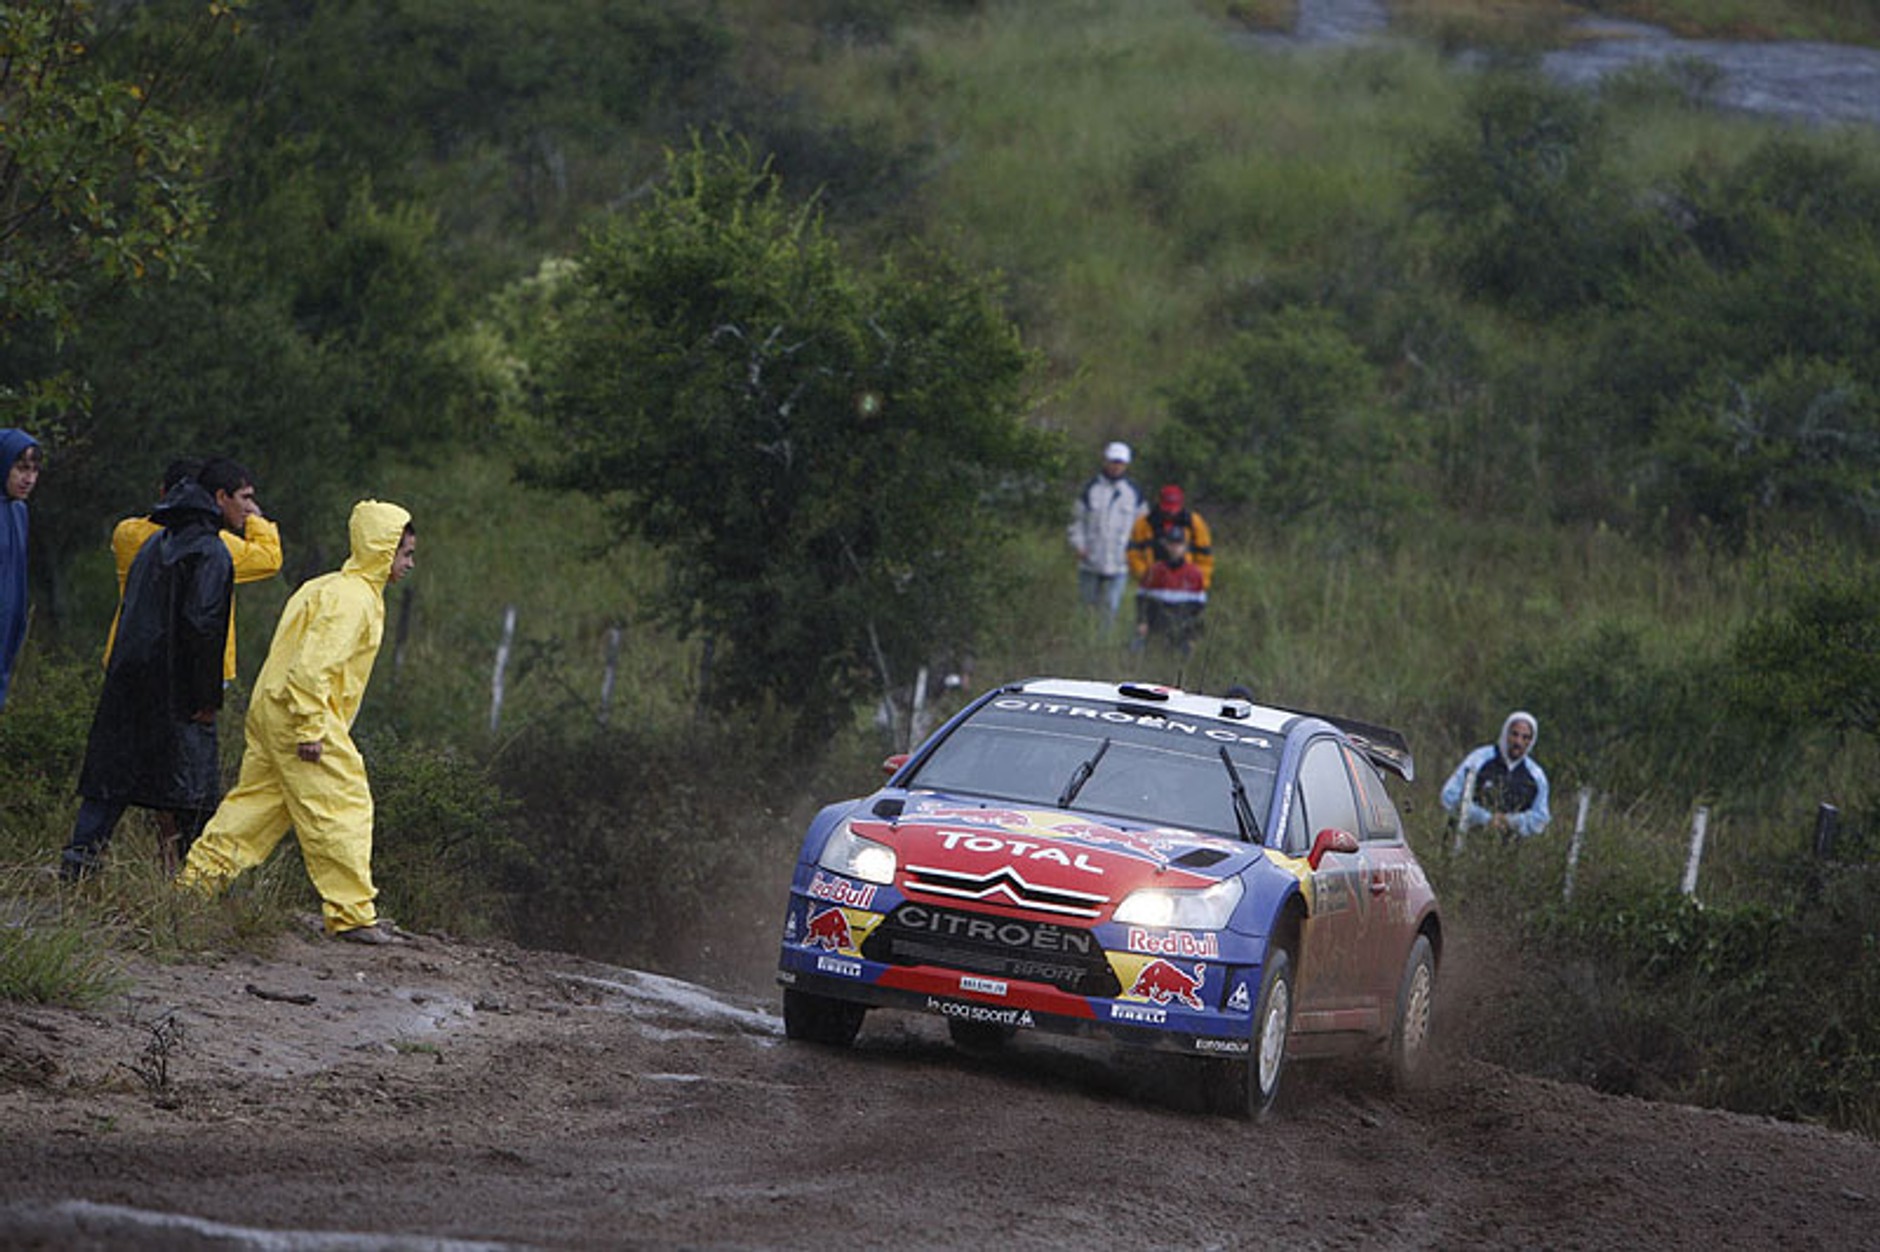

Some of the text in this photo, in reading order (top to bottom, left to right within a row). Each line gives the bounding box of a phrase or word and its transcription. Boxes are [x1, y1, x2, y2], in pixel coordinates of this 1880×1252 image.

[1205, 728, 1273, 748] C4
[936, 831, 1104, 875] TOTAL
[831, 879, 878, 909] Bull
[897, 906, 1091, 953] CITROËN
[1128, 927, 1218, 959] Red Bull
[941, 1003, 970, 1020] coq
[971, 1006, 1019, 1024] sportif
[1111, 1004, 1167, 1023] PIRELLI
